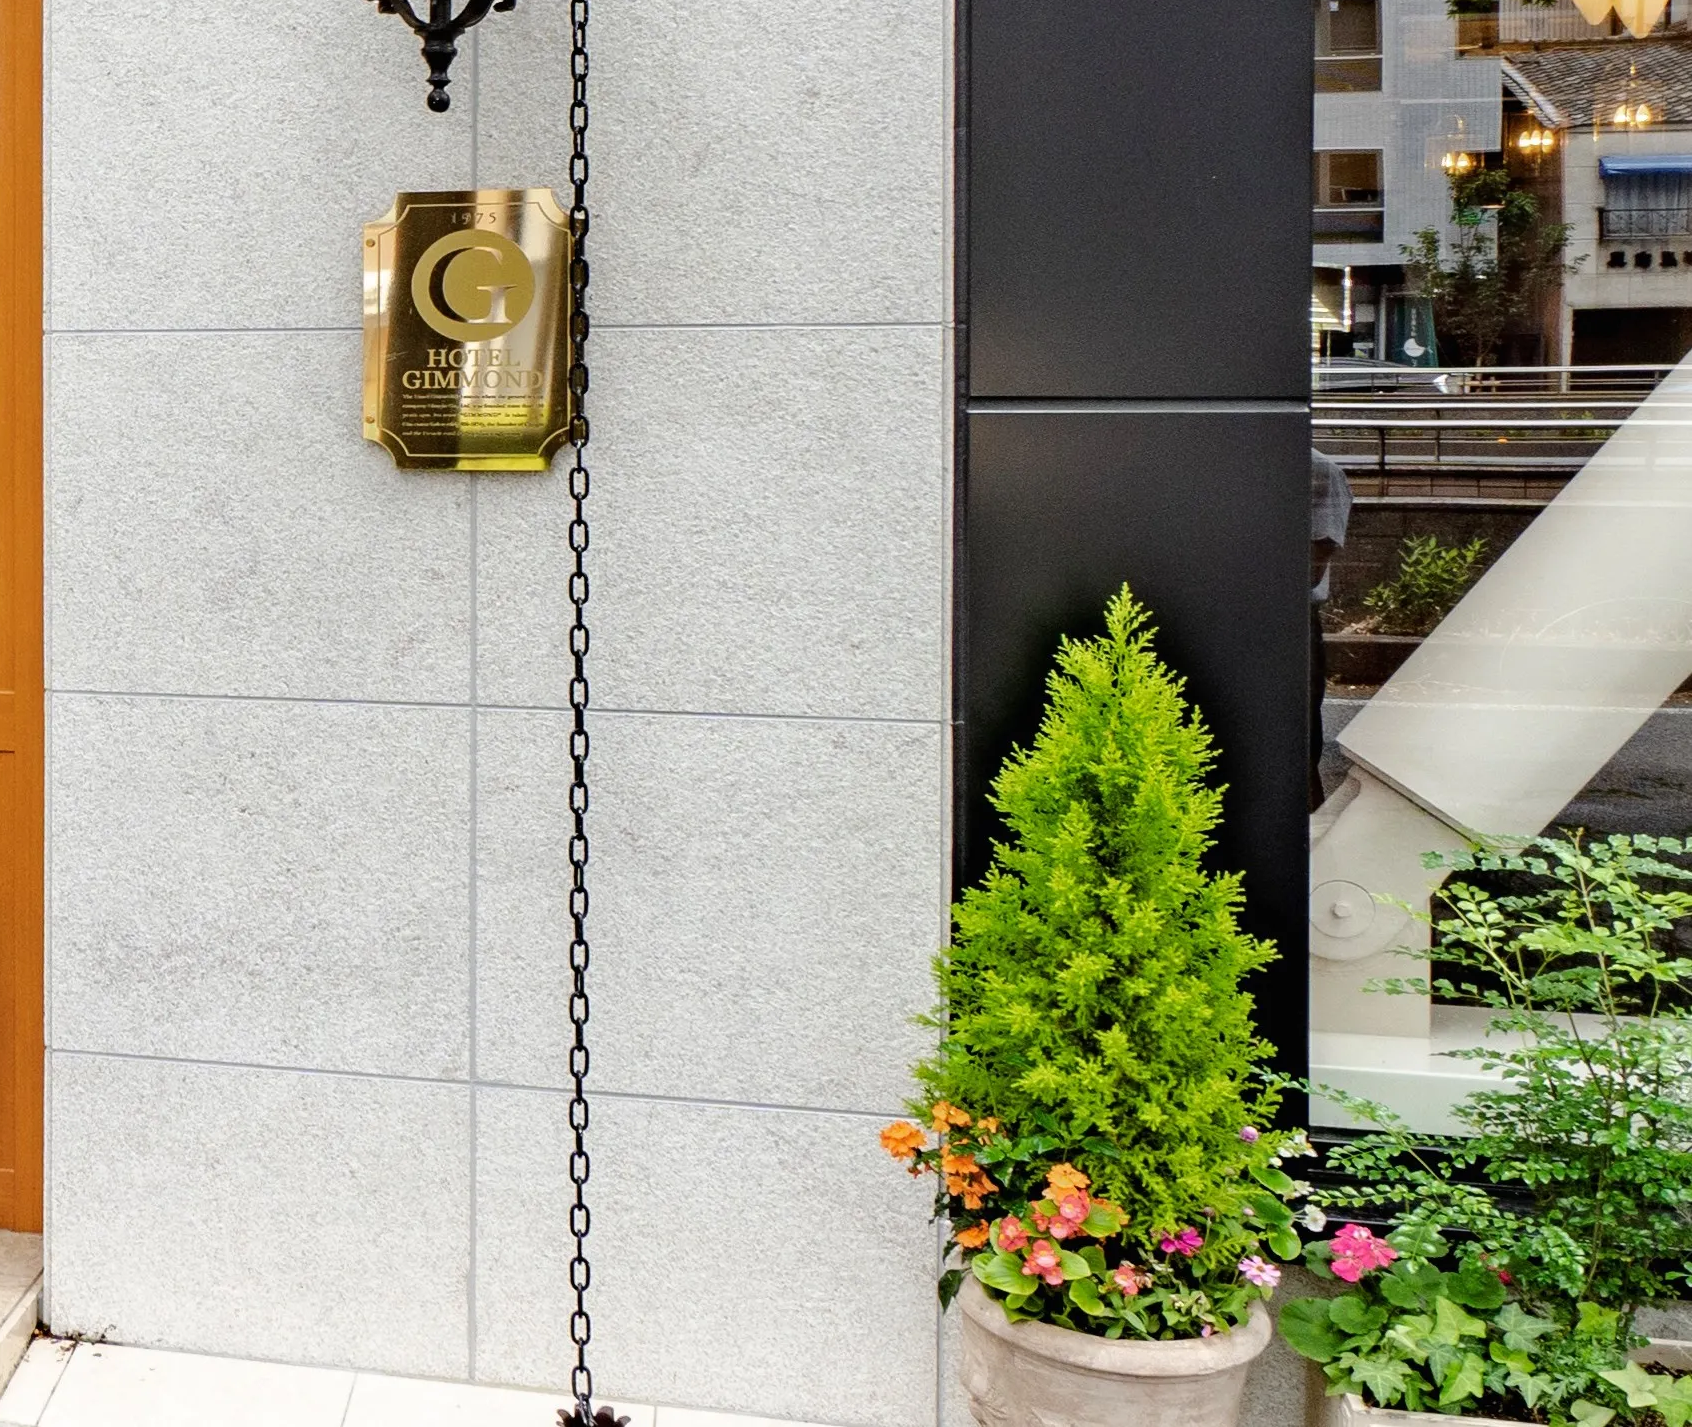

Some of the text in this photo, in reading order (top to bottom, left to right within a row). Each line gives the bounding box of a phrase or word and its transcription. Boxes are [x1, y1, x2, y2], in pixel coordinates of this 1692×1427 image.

[451, 212, 497, 225] 1975
[428, 246, 518, 324] G
[426, 348, 521, 368] HOTEL
[401, 370, 544, 390] GIMMOND
